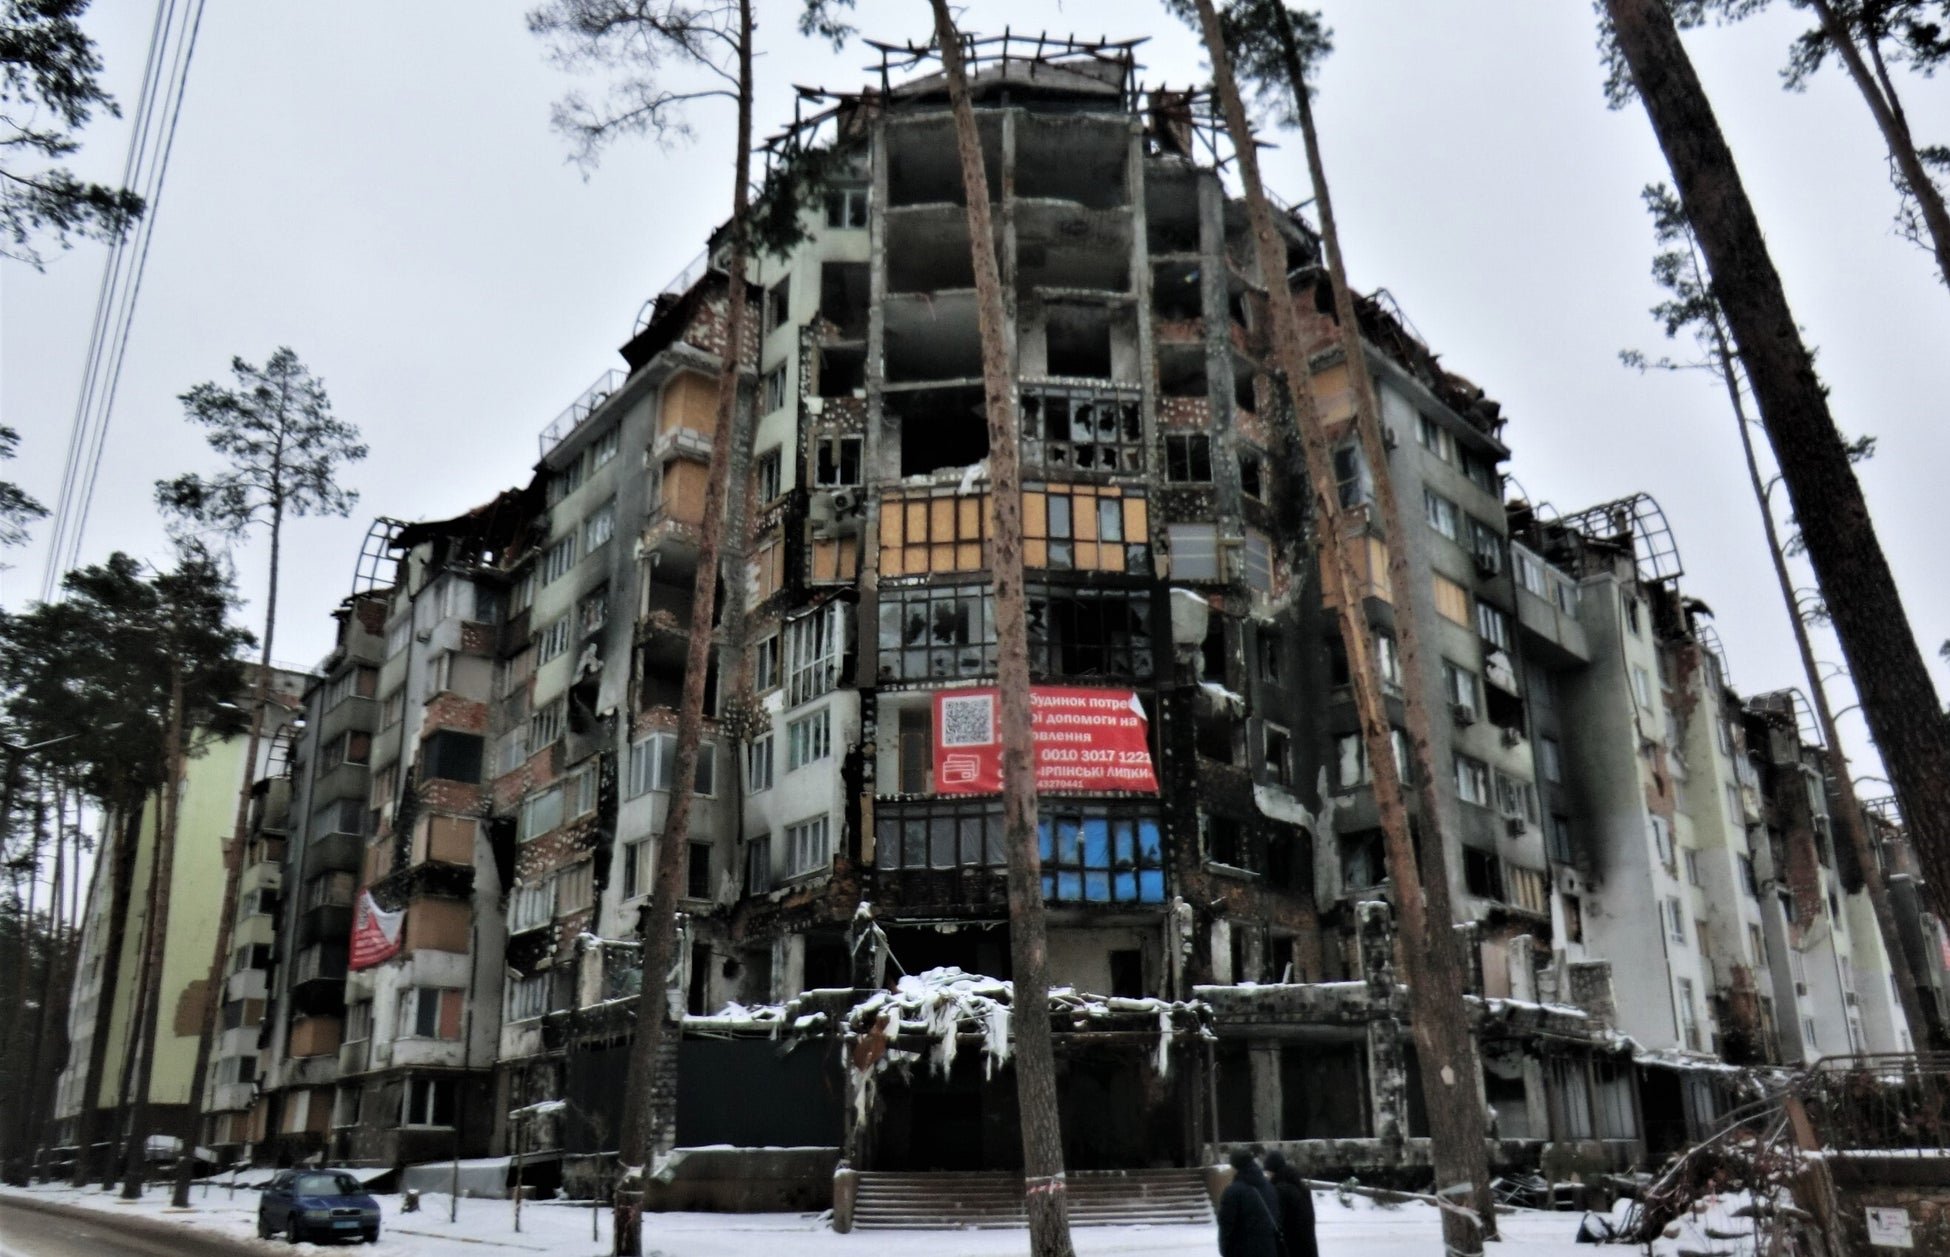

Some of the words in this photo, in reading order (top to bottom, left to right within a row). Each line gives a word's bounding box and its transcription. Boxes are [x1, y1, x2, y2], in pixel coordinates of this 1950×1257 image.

[1030, 692, 1086, 707] будинок
[1089, 697, 1129, 711] потре
[1046, 713, 1117, 726] допомоги
[1120, 717, 1138, 727] на
[1041, 748, 1078, 761] 0010
[1081, 749, 1116, 762] 3017
